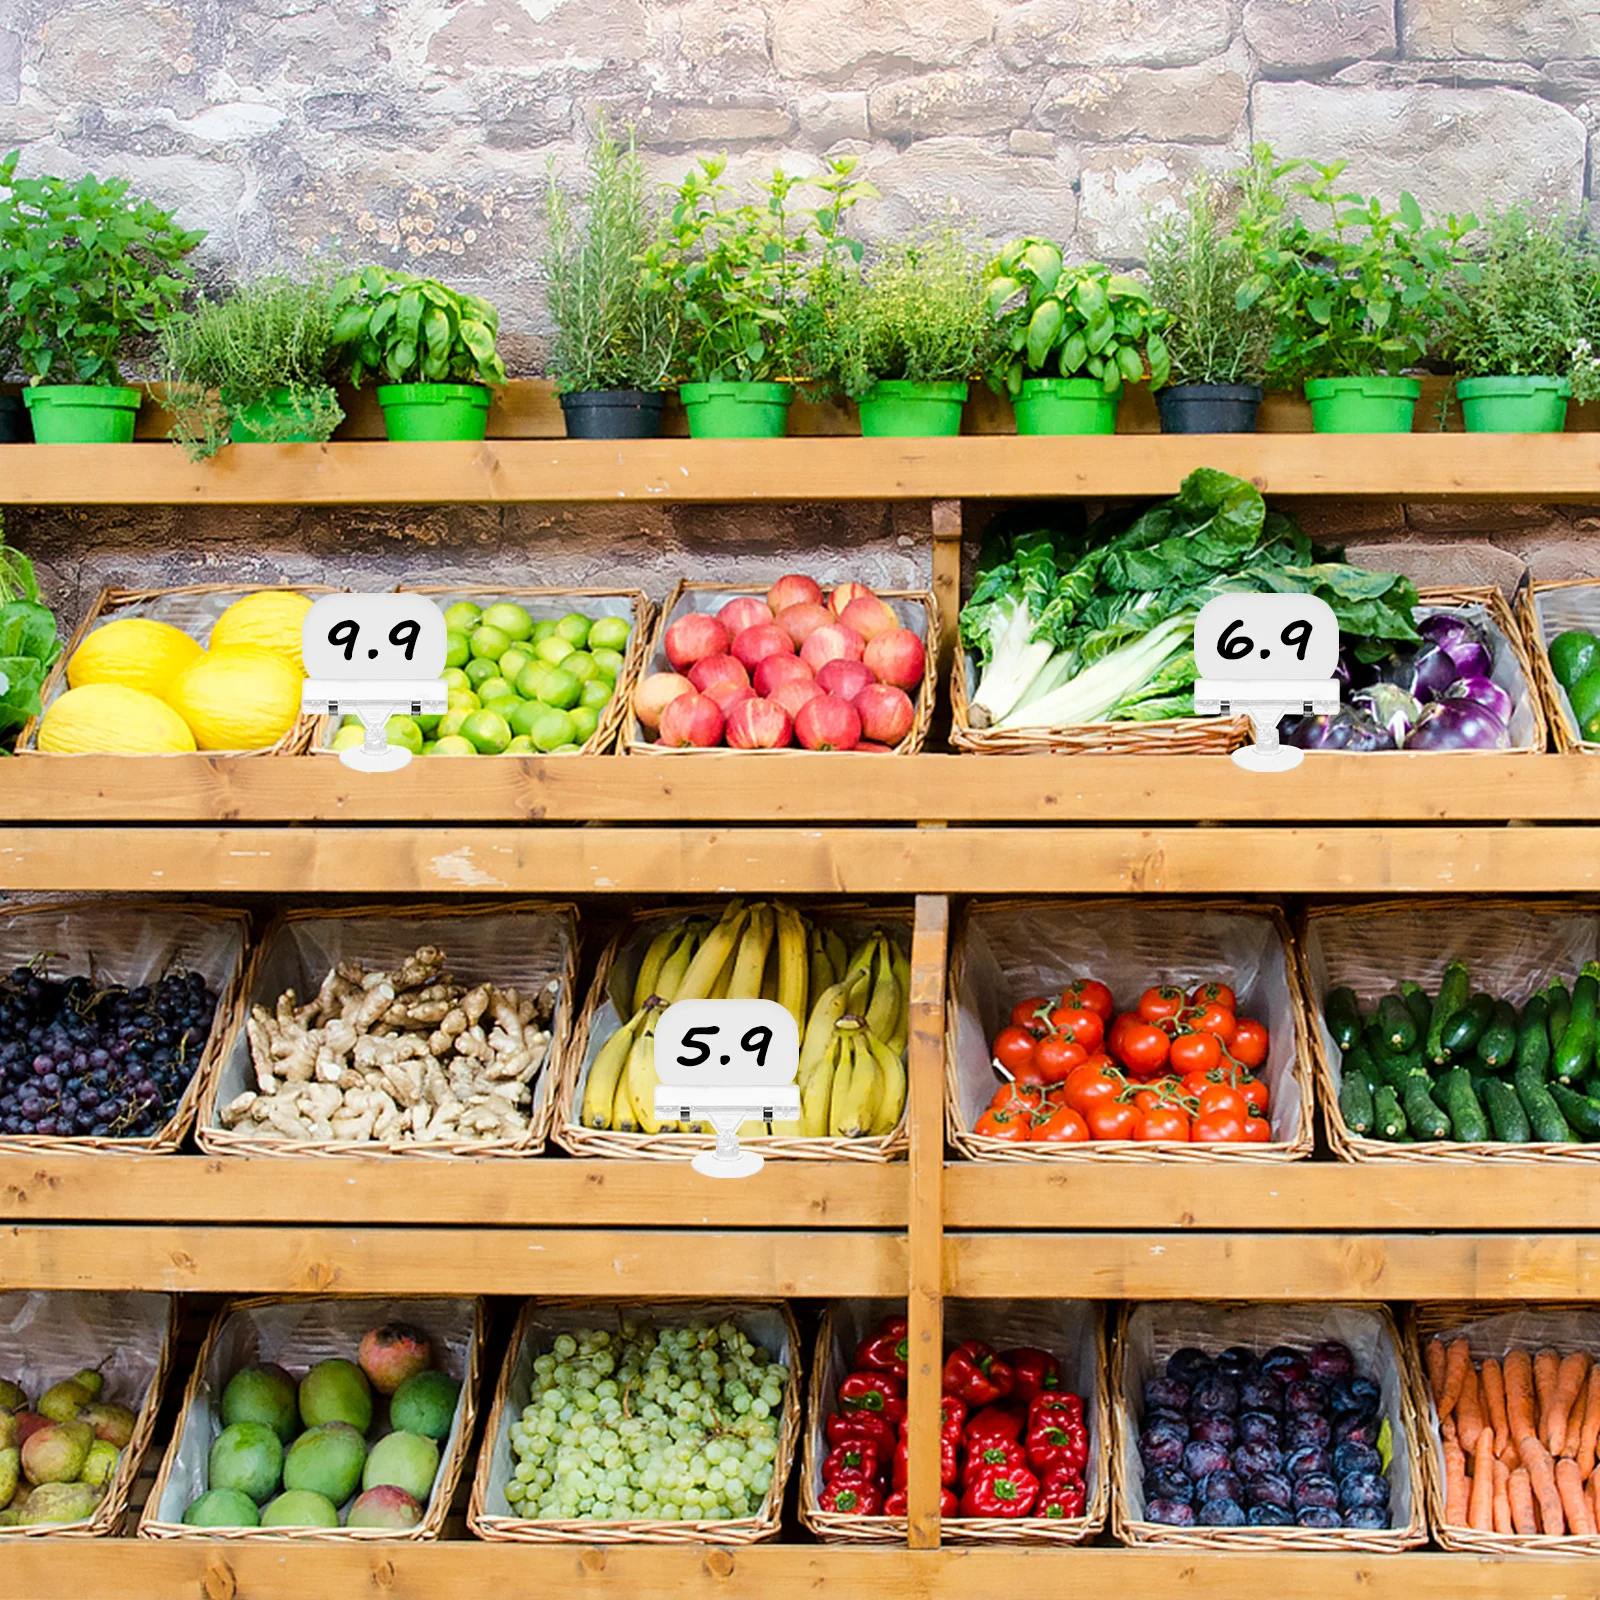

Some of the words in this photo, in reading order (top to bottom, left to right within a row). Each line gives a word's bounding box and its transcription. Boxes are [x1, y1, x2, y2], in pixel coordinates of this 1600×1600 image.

[327, 619, 421, 661] 9.9
[1216, 619, 1313, 661] 6.9
[676, 1025, 773, 1067] 5.9
